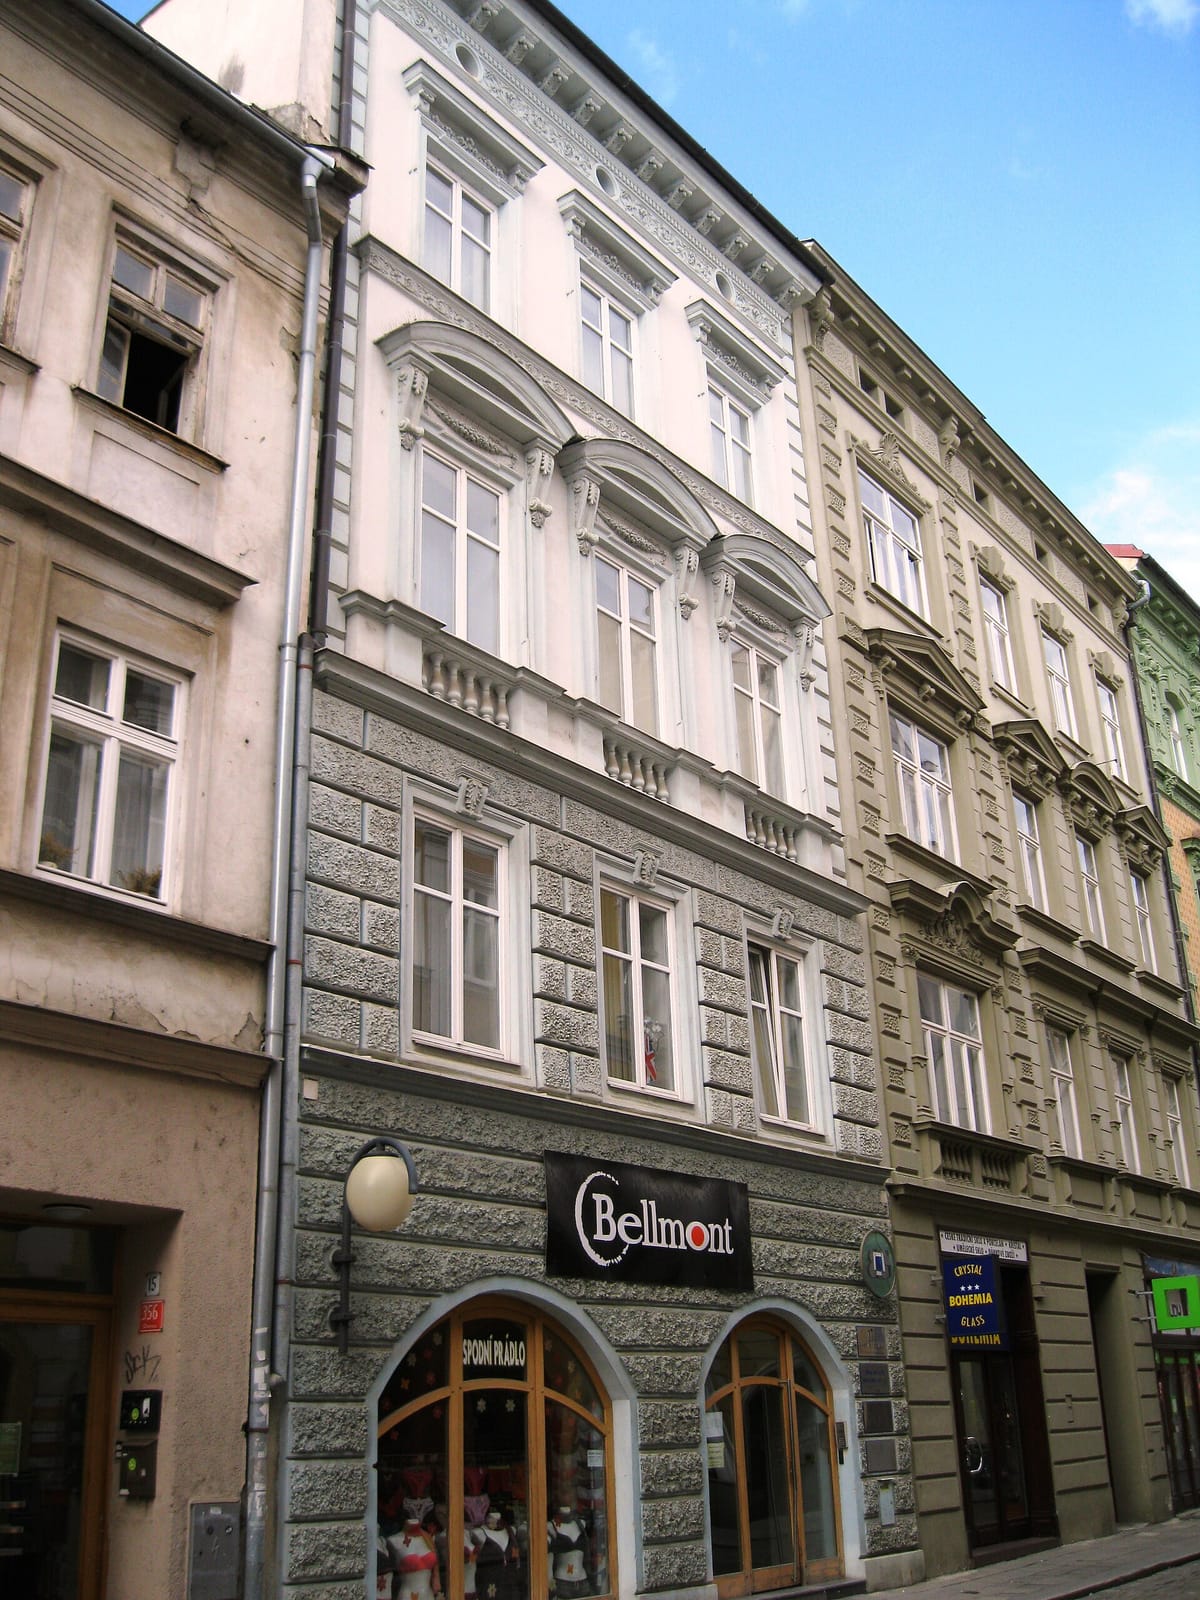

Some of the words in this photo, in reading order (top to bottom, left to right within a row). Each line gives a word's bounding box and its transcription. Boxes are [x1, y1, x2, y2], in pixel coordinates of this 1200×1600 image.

[592, 1193, 734, 1255] Bellmont
[954, 1264, 982, 1277] CRYSTAL
[148, 1276, 157, 1291] 15
[949, 1292, 993, 1307] BOHEMIA
[142, 1303, 159, 1320] 356
[961, 1314, 985, 1327] GLASS
[463, 1334, 493, 1366] SPODNÍ
[494, 1333, 526, 1367] PRÁDLO
